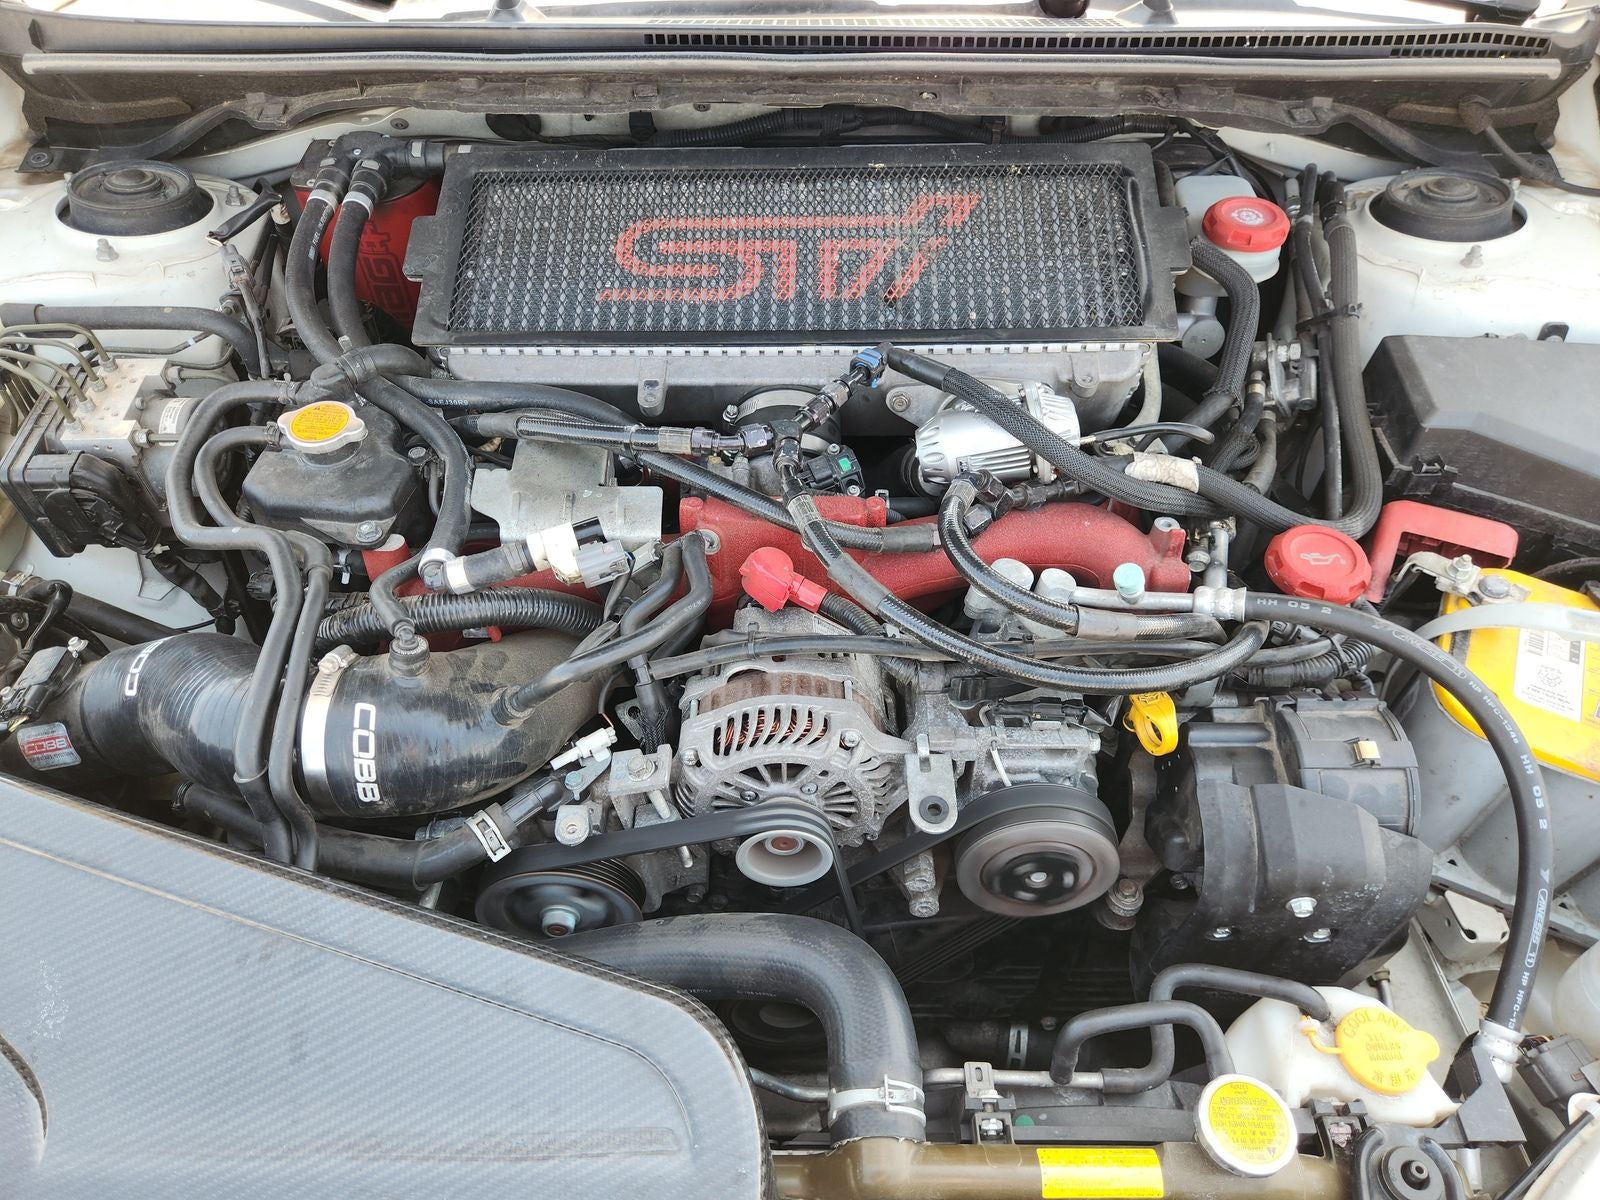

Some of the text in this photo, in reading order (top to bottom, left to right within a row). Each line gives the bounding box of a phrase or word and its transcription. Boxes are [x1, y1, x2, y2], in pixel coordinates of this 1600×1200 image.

[1257, 598, 1278, 606] HH
[1321, 606, 1333, 614] 2
[24, 738, 69, 754] COBB
[353, 702, 381, 802] COBB
[1520, 754, 1548, 830] HH 05 2
[1521, 972, 1530, 986] HP
[1344, 1010, 1410, 1038] COOLANT
